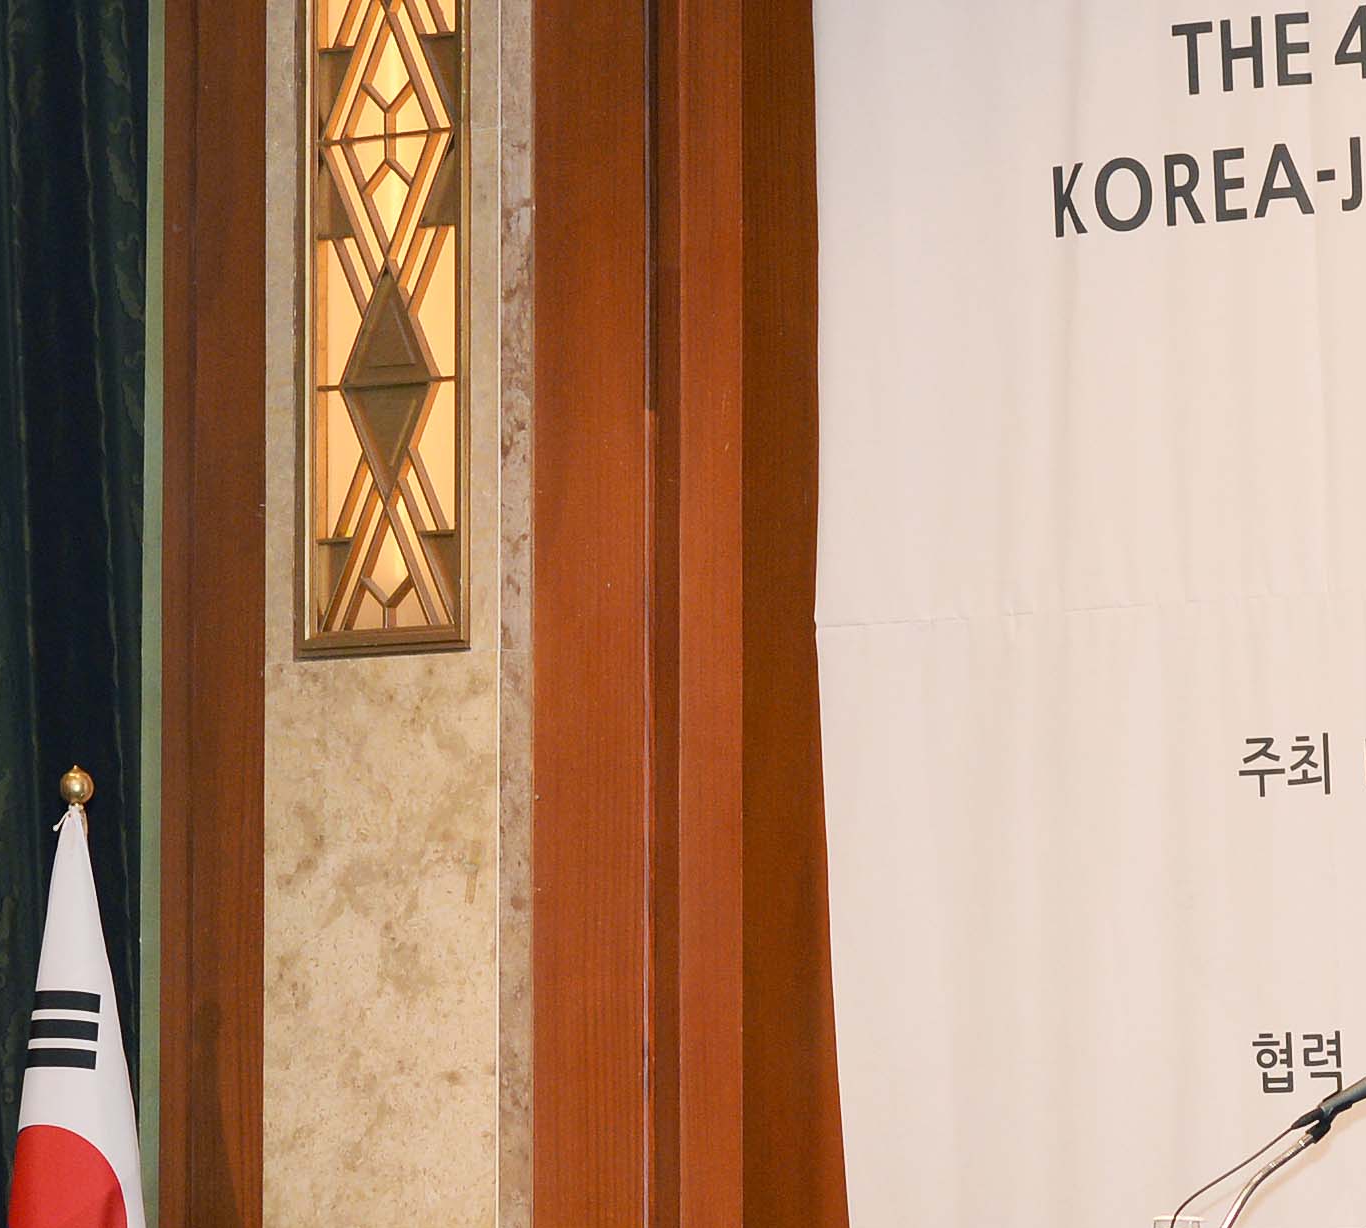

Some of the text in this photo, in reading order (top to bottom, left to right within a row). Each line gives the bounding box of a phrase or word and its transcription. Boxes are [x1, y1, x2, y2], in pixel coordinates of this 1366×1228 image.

[1171, 11, 1313, 96] THE
[1238, 732, 1331, 798] 주최
[1251, 1030, 1345, 1094] 협력
